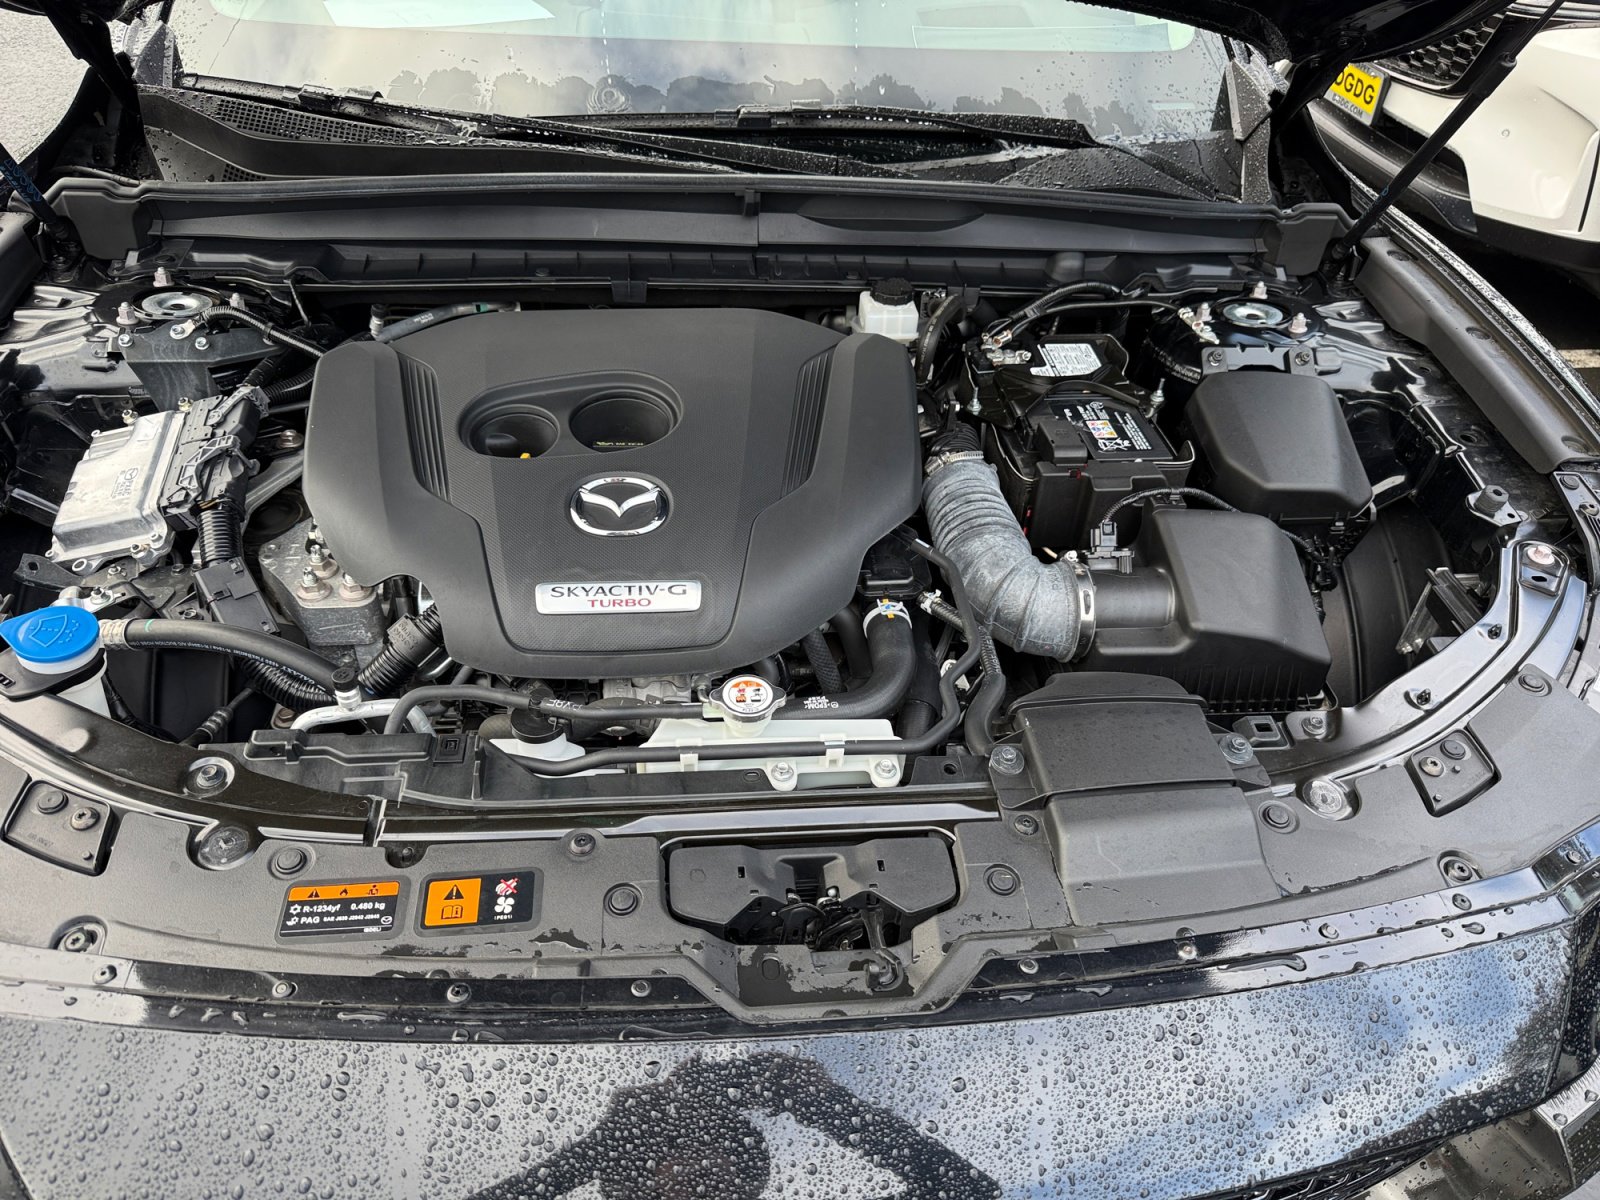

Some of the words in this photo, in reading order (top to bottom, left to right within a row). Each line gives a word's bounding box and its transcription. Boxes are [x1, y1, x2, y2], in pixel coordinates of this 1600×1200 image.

[551, 584, 687, 598] SKYACTIV-G
[587, 598, 652, 608] TURBO
[303, 904, 341, 913] R-1234yf
[350, 902, 373, 910] 0.480
[374, 901, 386, 910] kg
[300, 916, 320, 924] PAG
